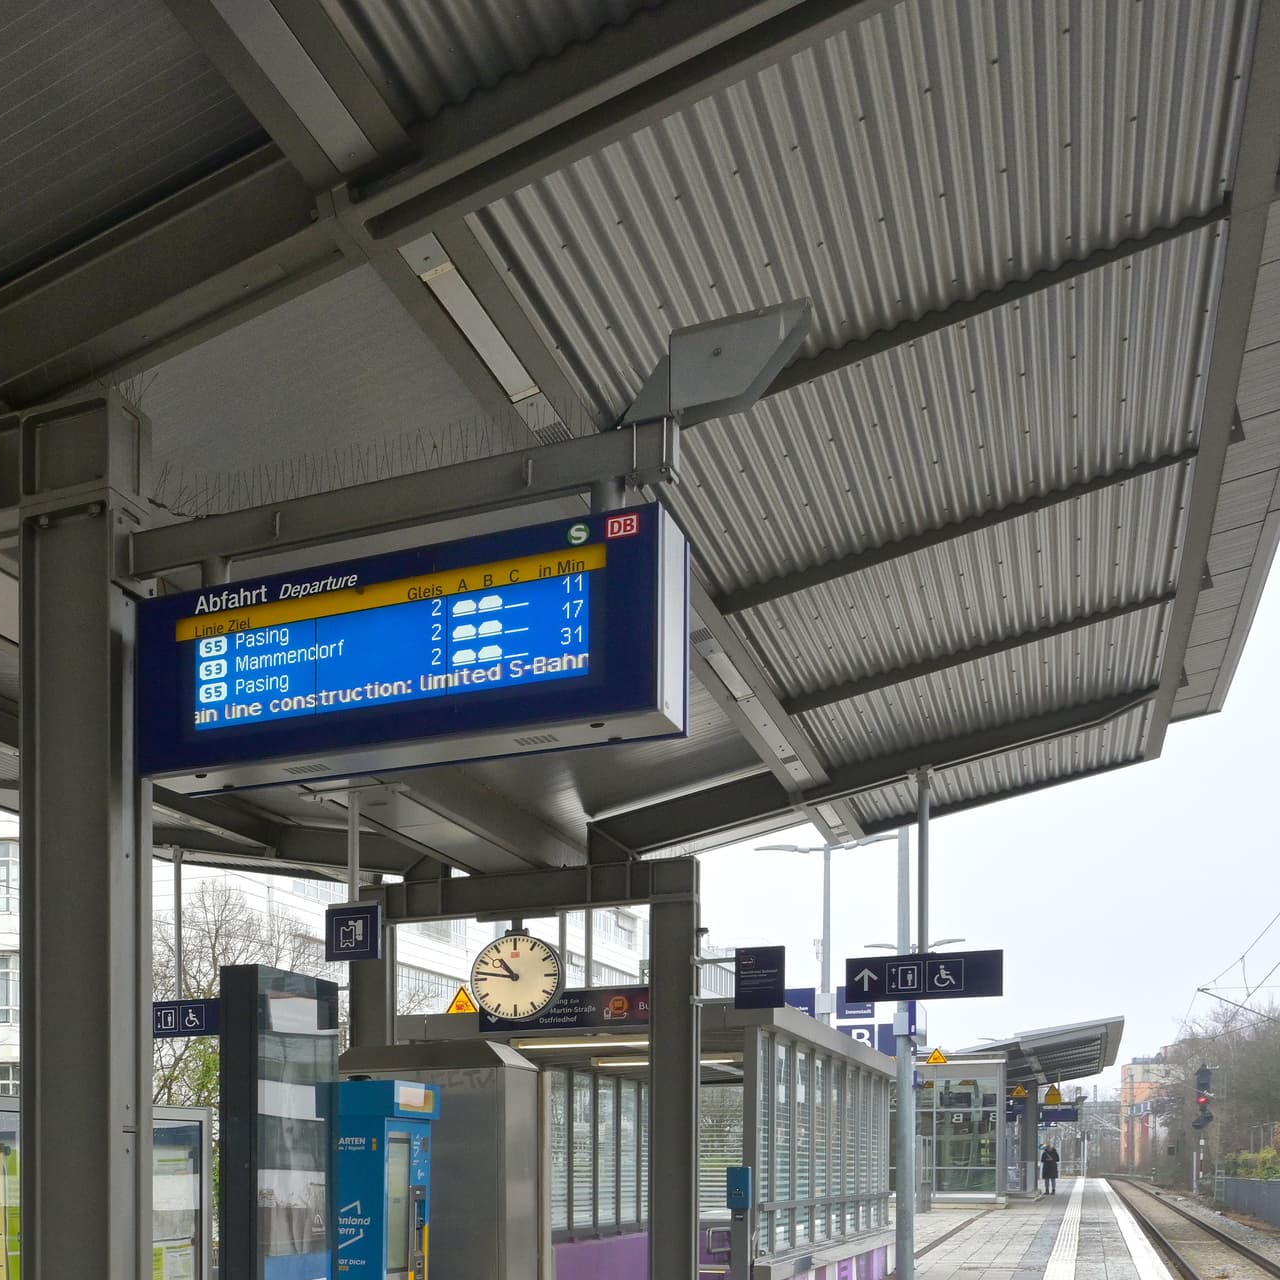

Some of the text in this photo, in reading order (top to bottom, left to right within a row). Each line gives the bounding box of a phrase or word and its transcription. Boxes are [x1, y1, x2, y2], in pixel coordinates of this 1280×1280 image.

[570, 525, 587, 544] S
[608, 516, 635, 537] DB
[194, 573, 358, 615] Abfahrt Departure
[195, 559, 585, 638] Linie Ziel Gleis A B C in Min
[204, 574, 583, 653] S5 Pasing 2 11
[204, 599, 584, 676] S3 Mammendorf 2 17
[204, 626, 583, 699] S5 Pasing 2 31
[224, 700, 262, 720] line
[269, 678, 413, 714] construction:
[420, 664, 501, 691] limited
[538, 1015, 578, 1024] Ostfriedhof
[851, 1028, 872, 1048] B
[338, 1227, 355, 1235] ern
